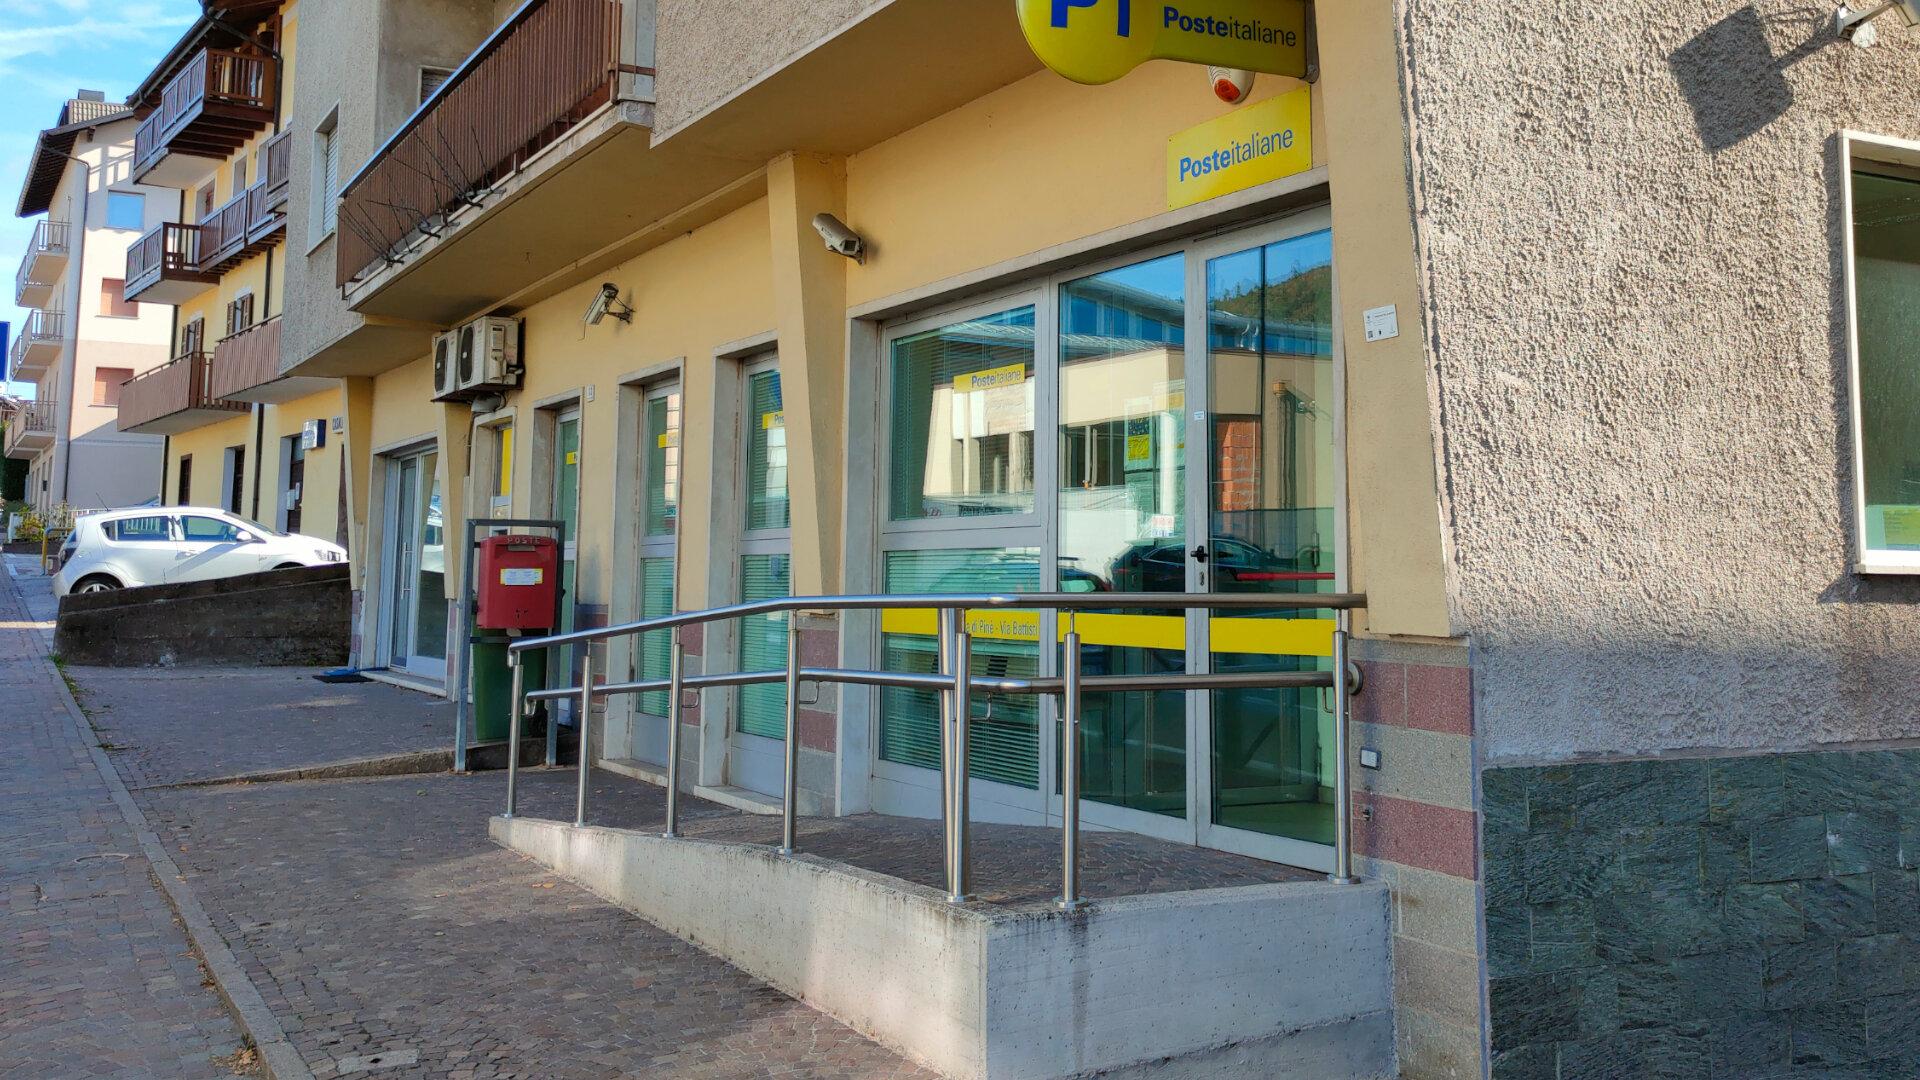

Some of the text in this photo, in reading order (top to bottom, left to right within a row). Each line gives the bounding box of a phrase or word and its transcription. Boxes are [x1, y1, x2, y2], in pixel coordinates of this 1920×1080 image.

[1163, 6, 1297, 48] Posteitaliane
[1179, 128, 1294, 182] Posteitaliane
[971, 368, 1022, 389] Posteitaliane
[507, 537, 541, 545] POSTE
[971, 619, 978, 633] di
[999, 619, 1011, 635] Via
[1012, 620, 1038, 637] Battisti
